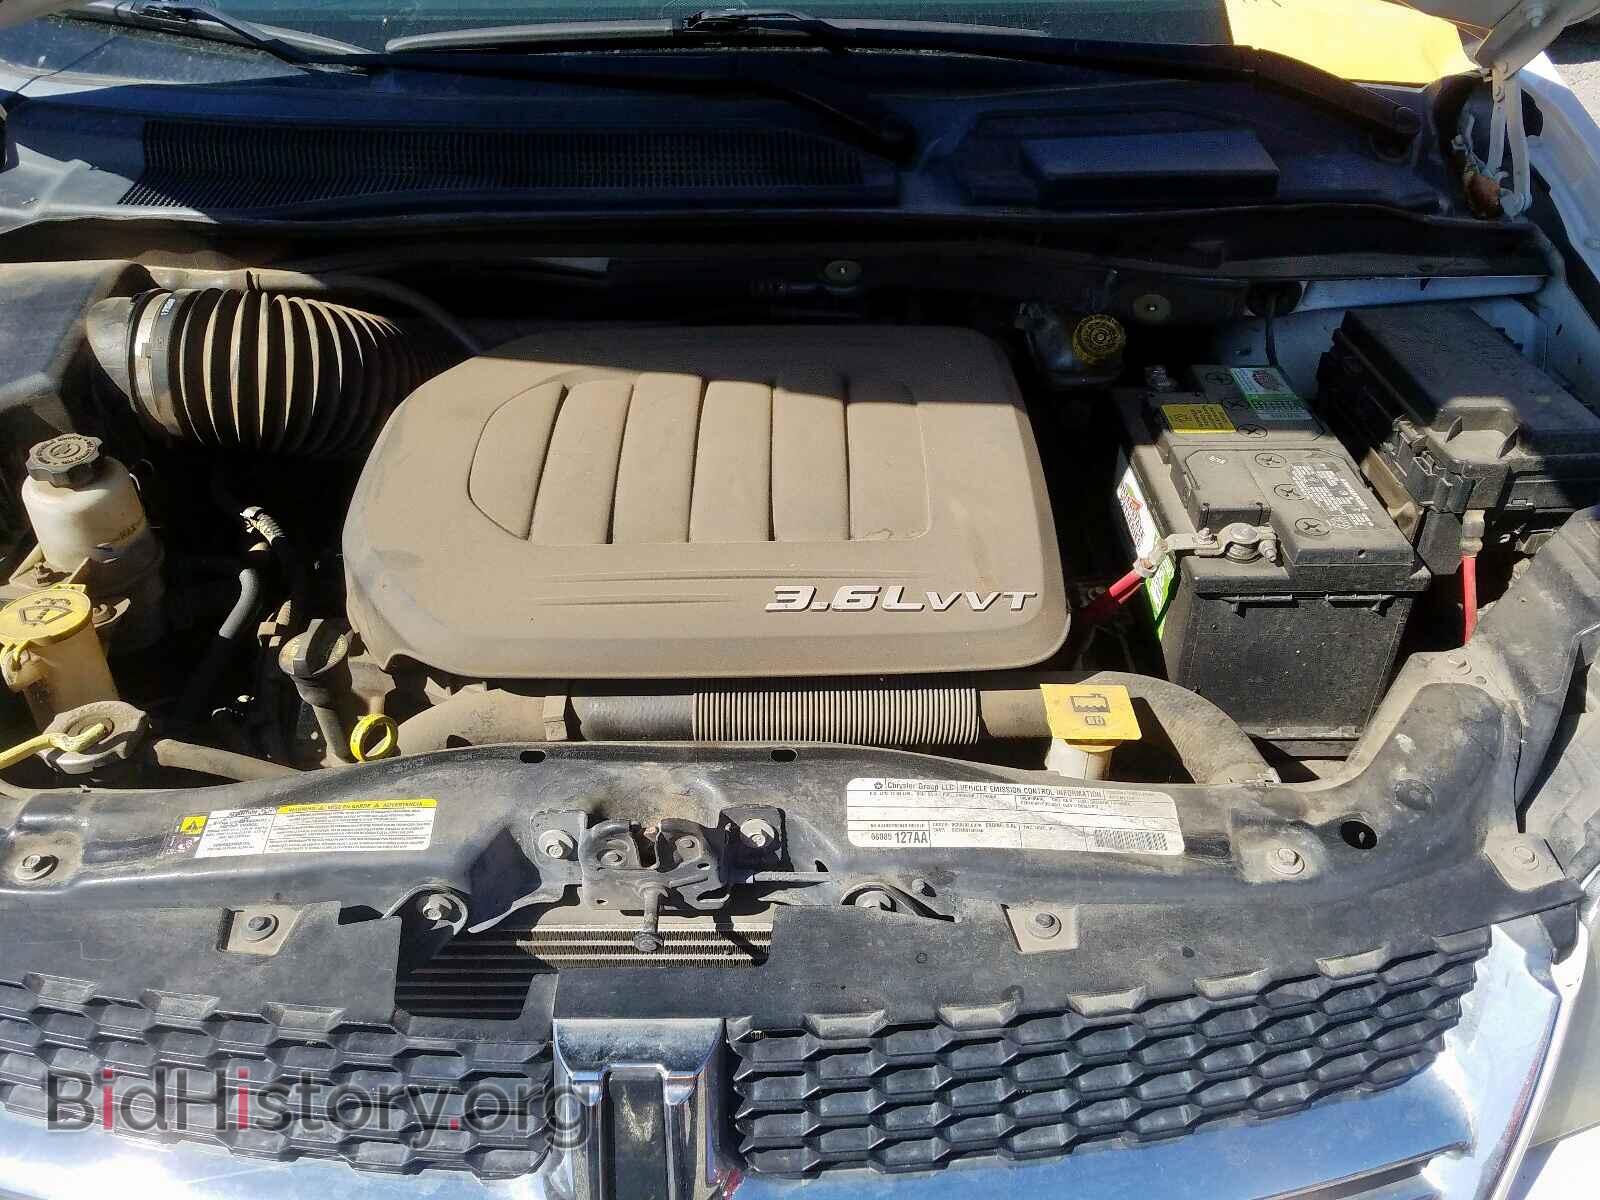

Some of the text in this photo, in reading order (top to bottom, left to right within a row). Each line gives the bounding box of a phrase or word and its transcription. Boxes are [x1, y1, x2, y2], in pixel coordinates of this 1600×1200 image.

[925, 591, 1038, 612] VVT
[887, 781, 954, 792] Chrysler Group LLC
[959, 784, 987, 793] VEHICLE
[989, 785, 1021, 794] EMISSION
[1023, 786, 1055, 796] CONTROL
[1057, 789, 1103, 798] INFORMATION
[894, 831, 929, 844] 127AA
